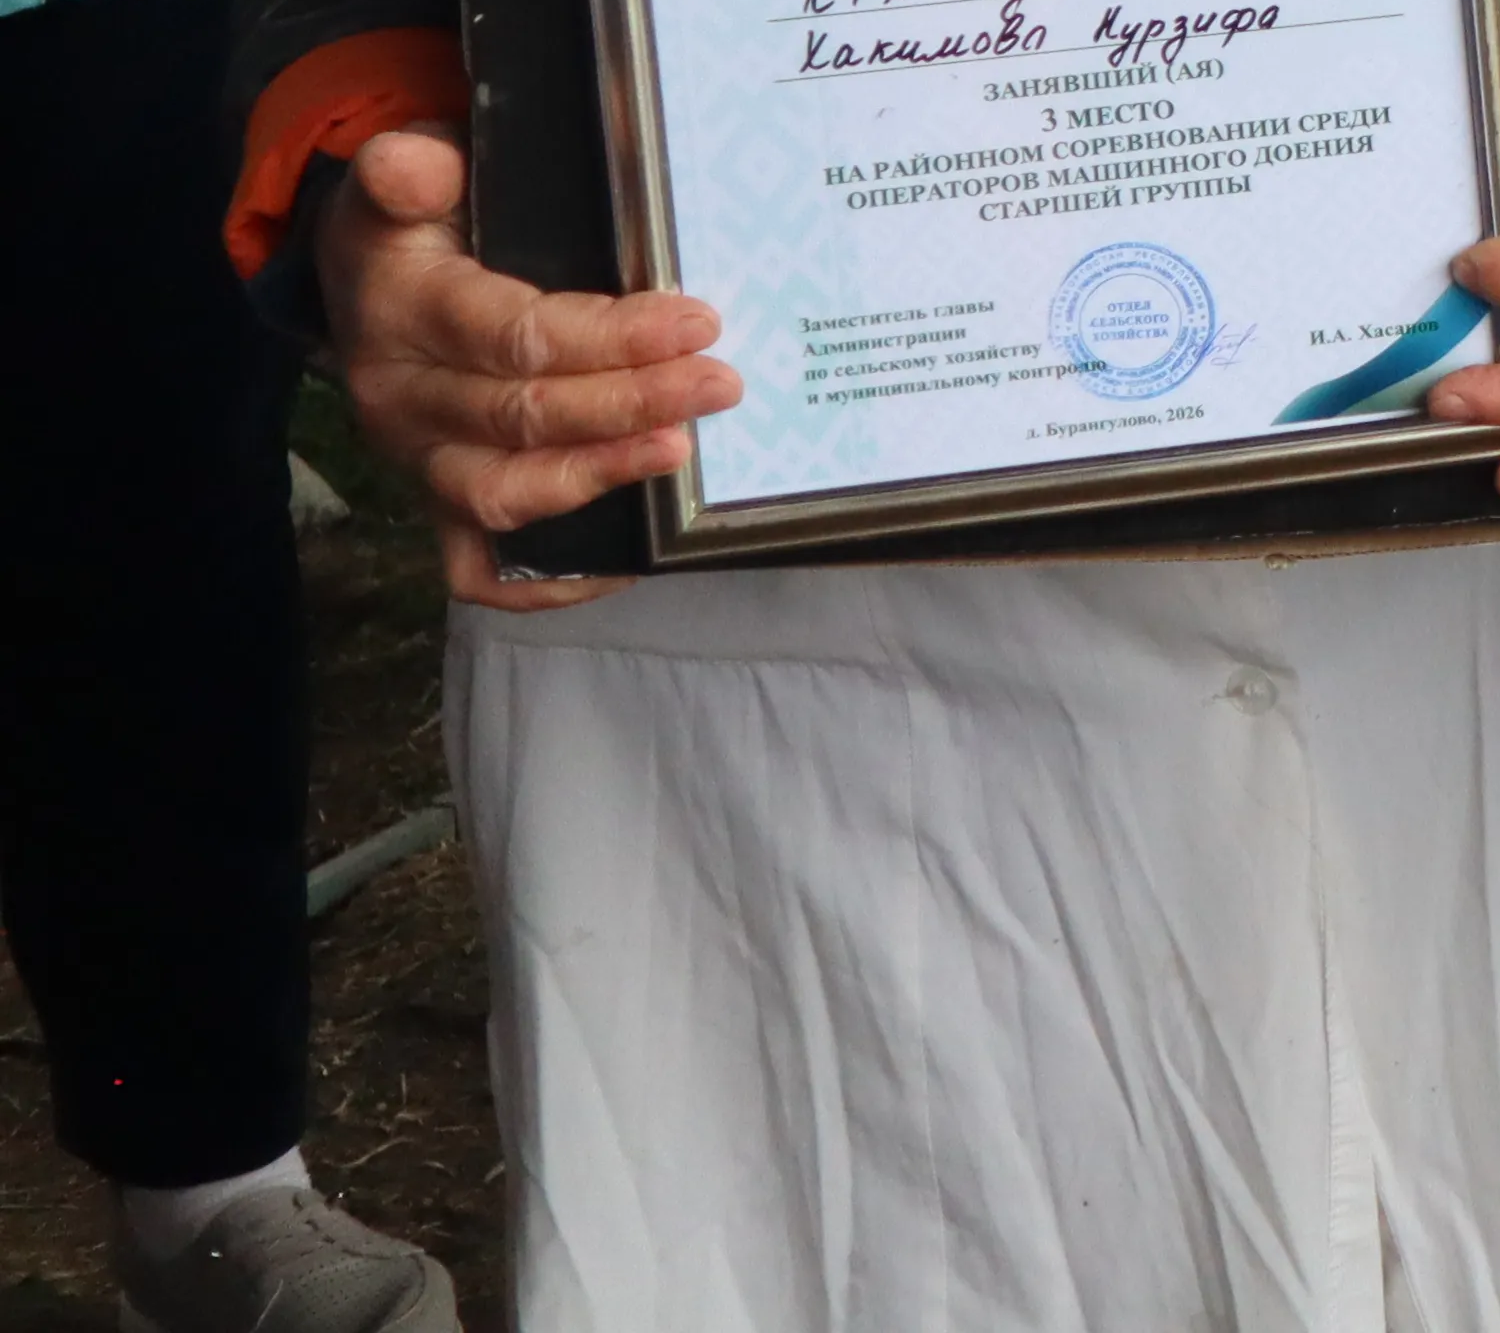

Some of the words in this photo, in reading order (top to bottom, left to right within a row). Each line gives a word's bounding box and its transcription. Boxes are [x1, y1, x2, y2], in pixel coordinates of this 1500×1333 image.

[983, 62, 1158, 102] ЗАНЯВШИЙ
[1166, 59, 1225, 85] (АЯ)
[1041, 108, 1058, 132] 3
[1066, 100, 1174, 129] МЕСТО
[824, 165, 866, 187] НА
[872, 143, 1044, 183] РАЙОННОМ
[1052, 119, 1290, 162] СОРЕВНОВАНИИ
[1298, 105, 1391, 135] СРЕДИ
[847, 172, 1040, 211] ОПЕРАТОРОВ
[1047, 149, 1246, 188] МАШИННОГО
[1253, 134, 1374, 169] ДОЕНИЯ
[979, 187, 1122, 222] СТАРШЕЙ
[1130, 173, 1251, 206] ГРУППЫ
[799, 305, 928, 333] Заместитель
[933, 298, 994, 318] главы
[1359, 318, 1439, 341] Хасанов
[802, 325, 966, 357] Администрации
[805, 364, 826, 383] по
[833, 352, 939, 380] сельскому
[946, 341, 1042, 369] хозяйству
[824, 374, 1001, 401] муниципальному
[1008, 358, 1108, 386] контролю
[1167, 405, 1205, 422] 2026
